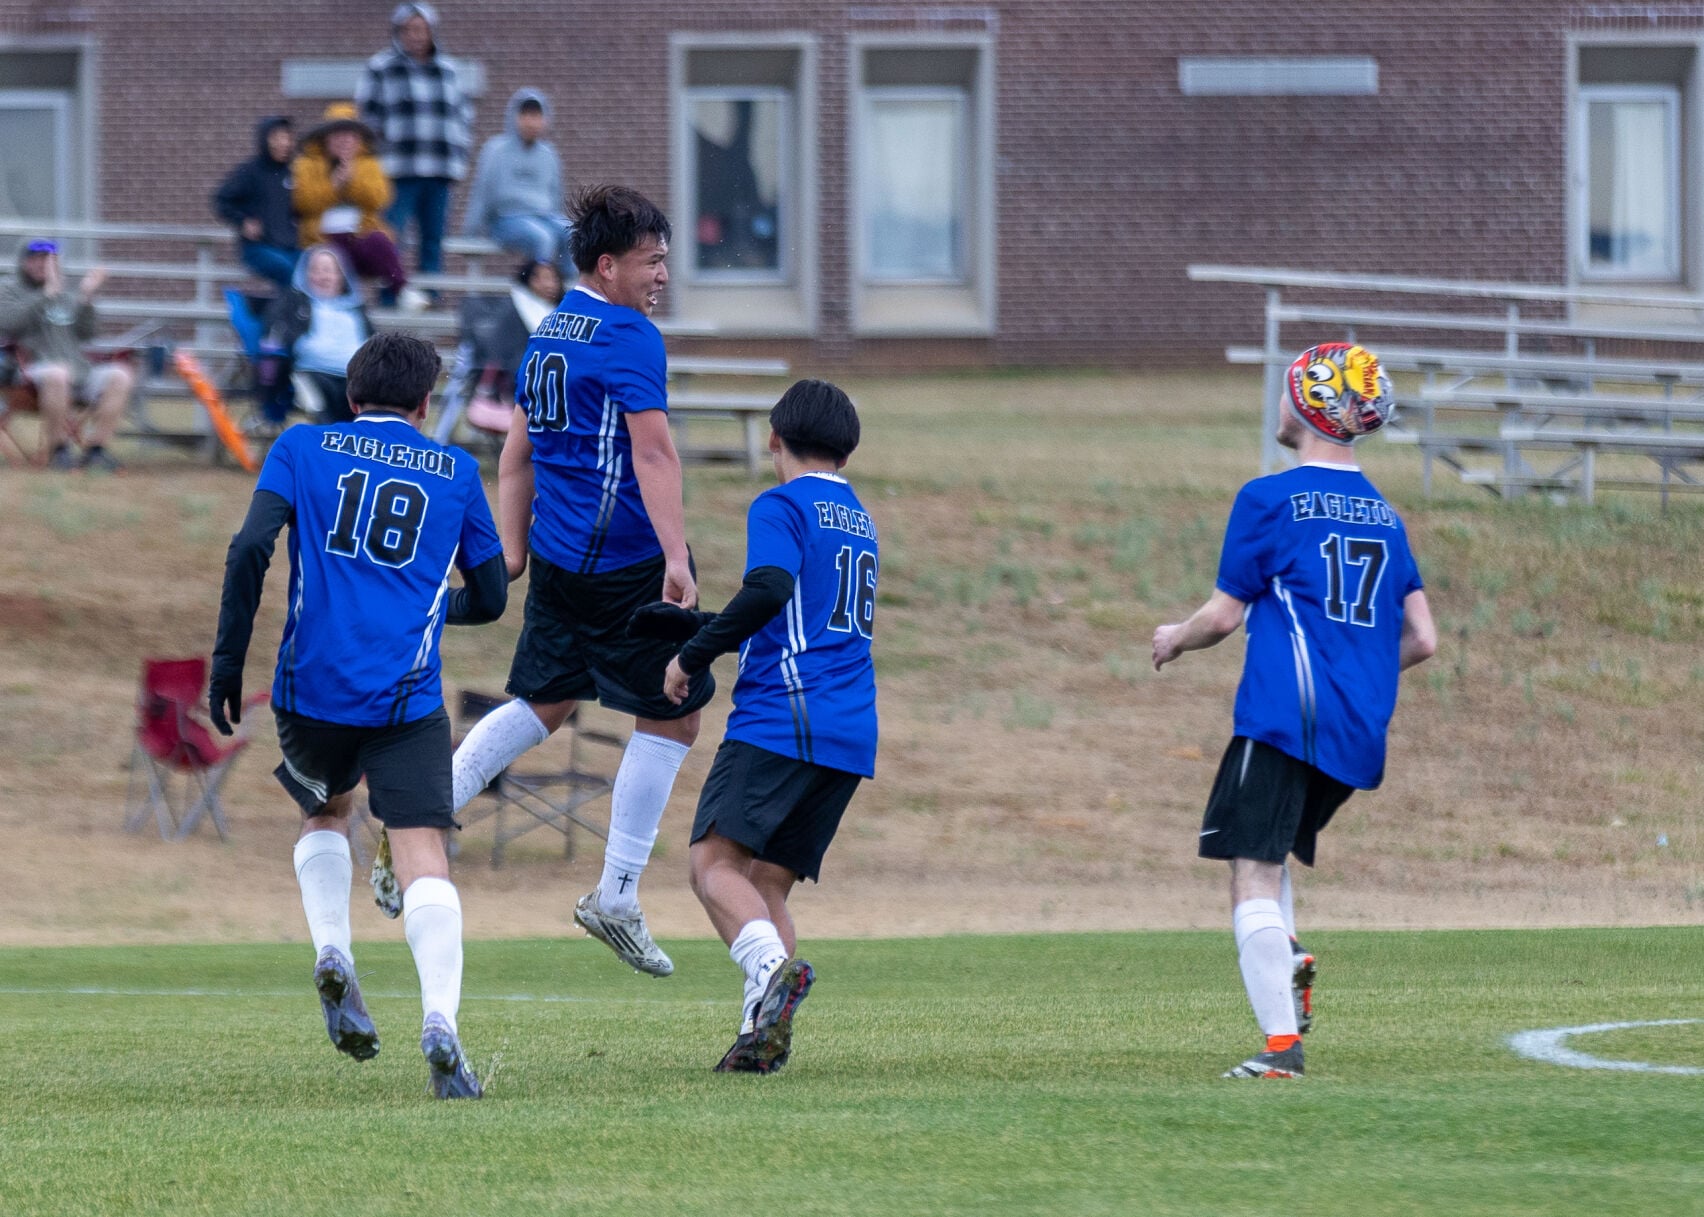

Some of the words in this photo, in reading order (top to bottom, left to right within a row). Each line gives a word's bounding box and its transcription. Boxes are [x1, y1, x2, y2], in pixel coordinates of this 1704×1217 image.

[525, 351, 569, 432] 10
[321, 432, 455, 480] EAGLETON
[325, 468, 429, 569] 18
[827, 545, 878, 640] 16
[1320, 533, 1389, 627] 17
